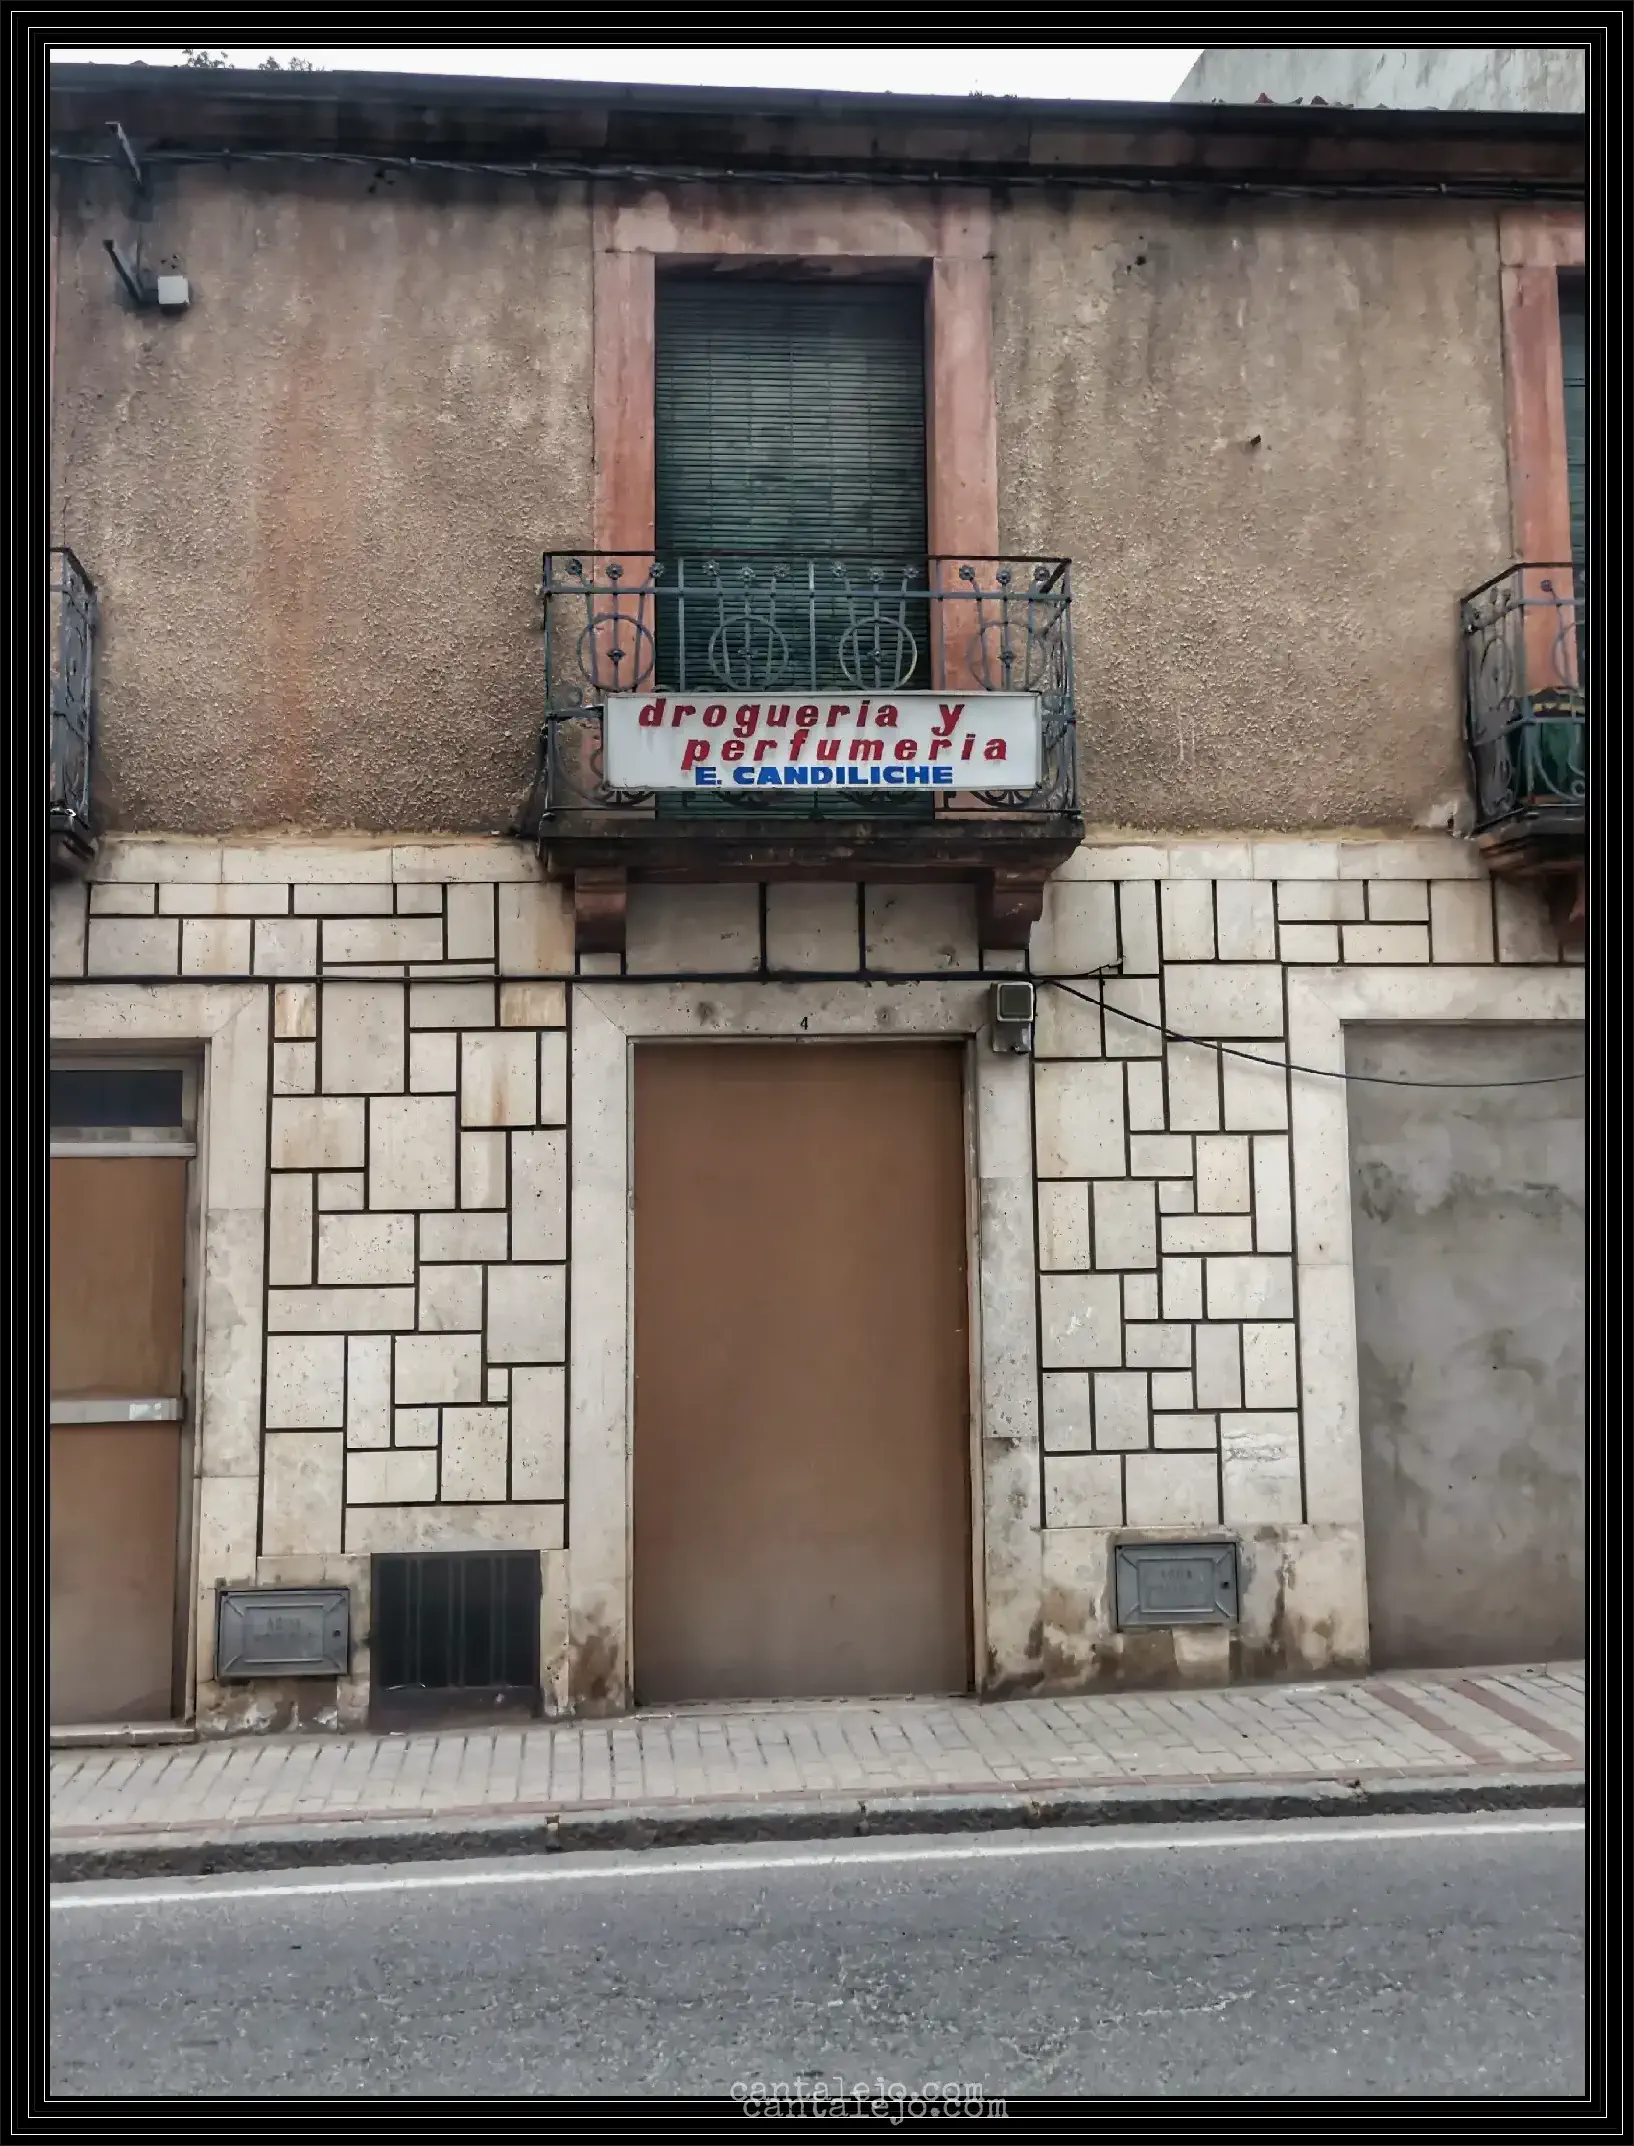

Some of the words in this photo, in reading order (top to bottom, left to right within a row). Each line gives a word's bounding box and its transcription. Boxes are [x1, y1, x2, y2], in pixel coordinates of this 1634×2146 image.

[639, 698, 898, 738] drogueria
[931, 704, 966, 737] y
[681, 730, 1007, 771] perfumeria
[695, 767, 722, 786] E.
[733, 766, 953, 785] CANDILICHE
[800, 1016, 808, 1030] 4
